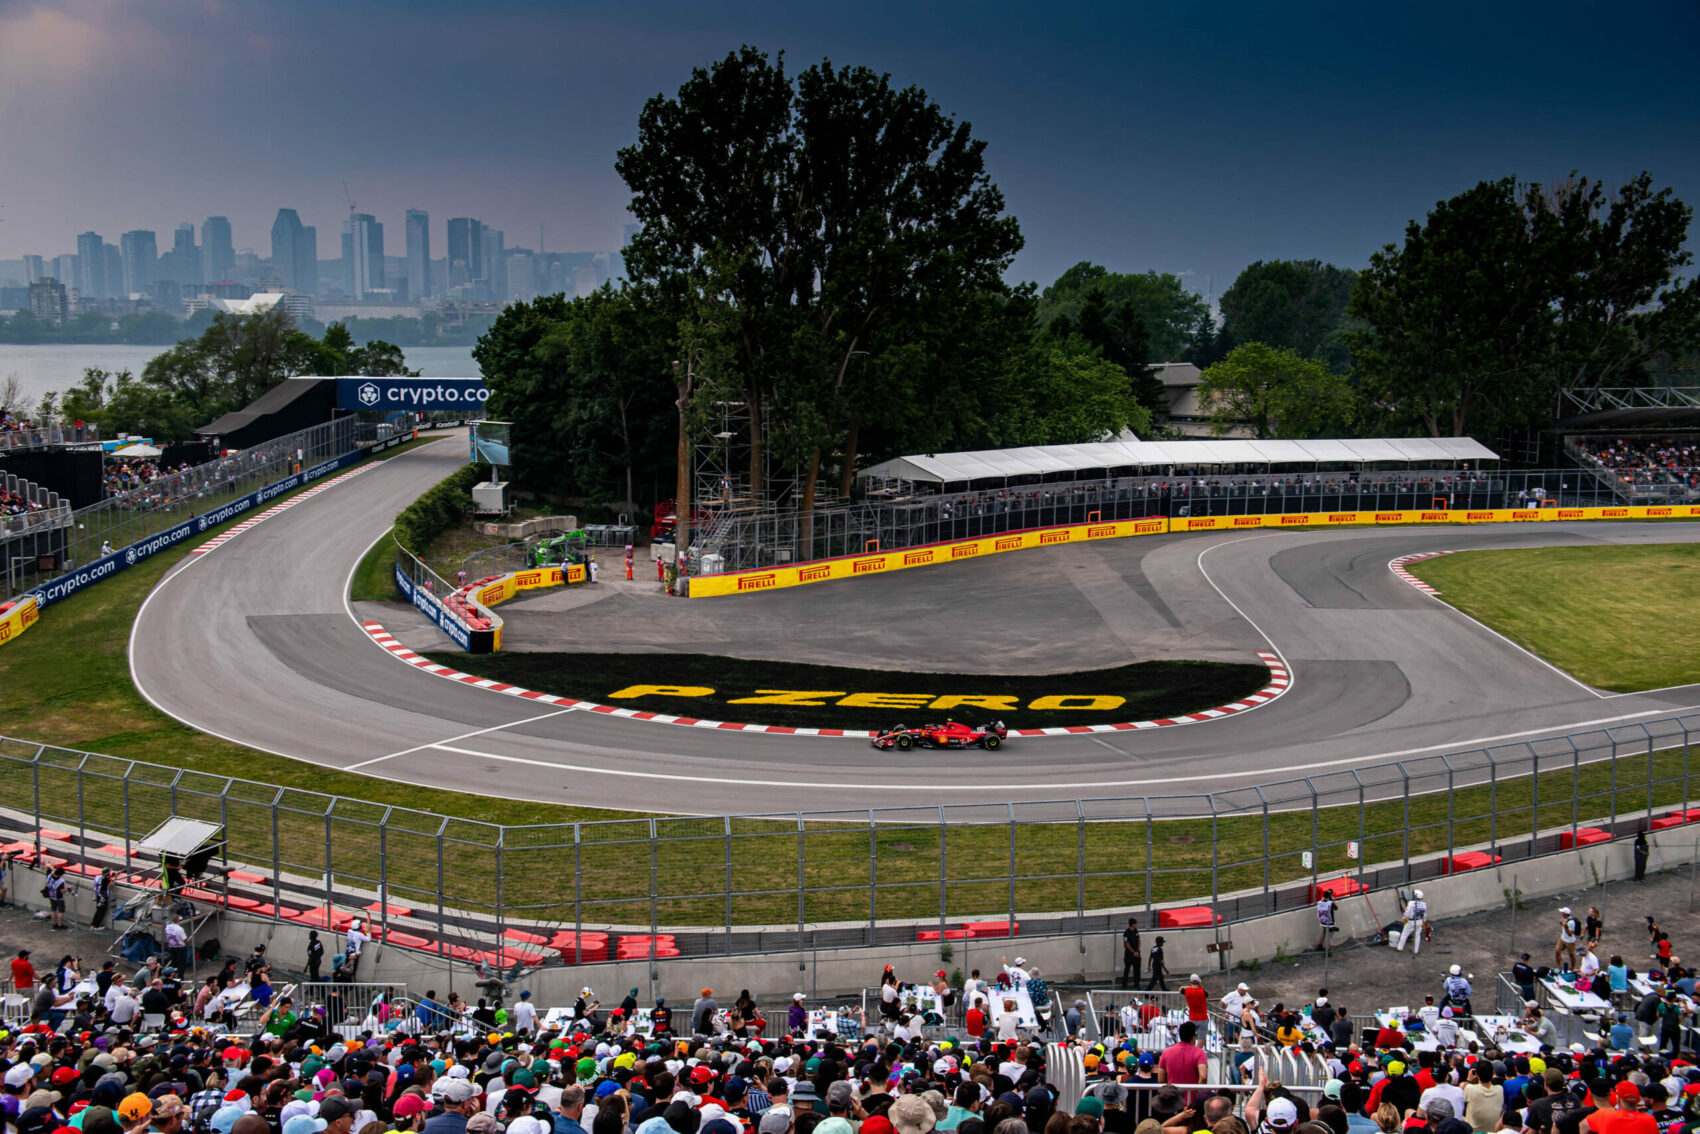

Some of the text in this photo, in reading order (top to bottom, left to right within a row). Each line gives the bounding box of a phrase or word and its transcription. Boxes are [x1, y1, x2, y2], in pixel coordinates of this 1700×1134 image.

[309, 461, 339, 479] crypto.com
[263, 478, 298, 499] crypto.com
[208, 499, 250, 524] crypto.com
[1088, 526, 1116, 537] PIRELLI
[1134, 521, 1162, 533] PIRELLI
[137, 525, 190, 558] crypto.com
[995, 537, 1022, 550] PIRELLI
[1040, 531, 1070, 544] PIRELLI
[904, 551, 933, 565] PIRELLI
[952, 544, 978, 558] PIRELLI
[799, 566, 830, 581] PIRELLI
[853, 558, 885, 573] PIRELLI
[47, 560, 115, 600] crypto.com
[552, 568, 581, 583] PIRLLI
[738, 574, 775, 590] PIRELLI
[483, 585, 504, 605] PIRELLI
[416, 594, 437, 620] crypto.com
[444, 619, 468, 648] crypto.com
[608, 684, 1126, 711] P ZERO
